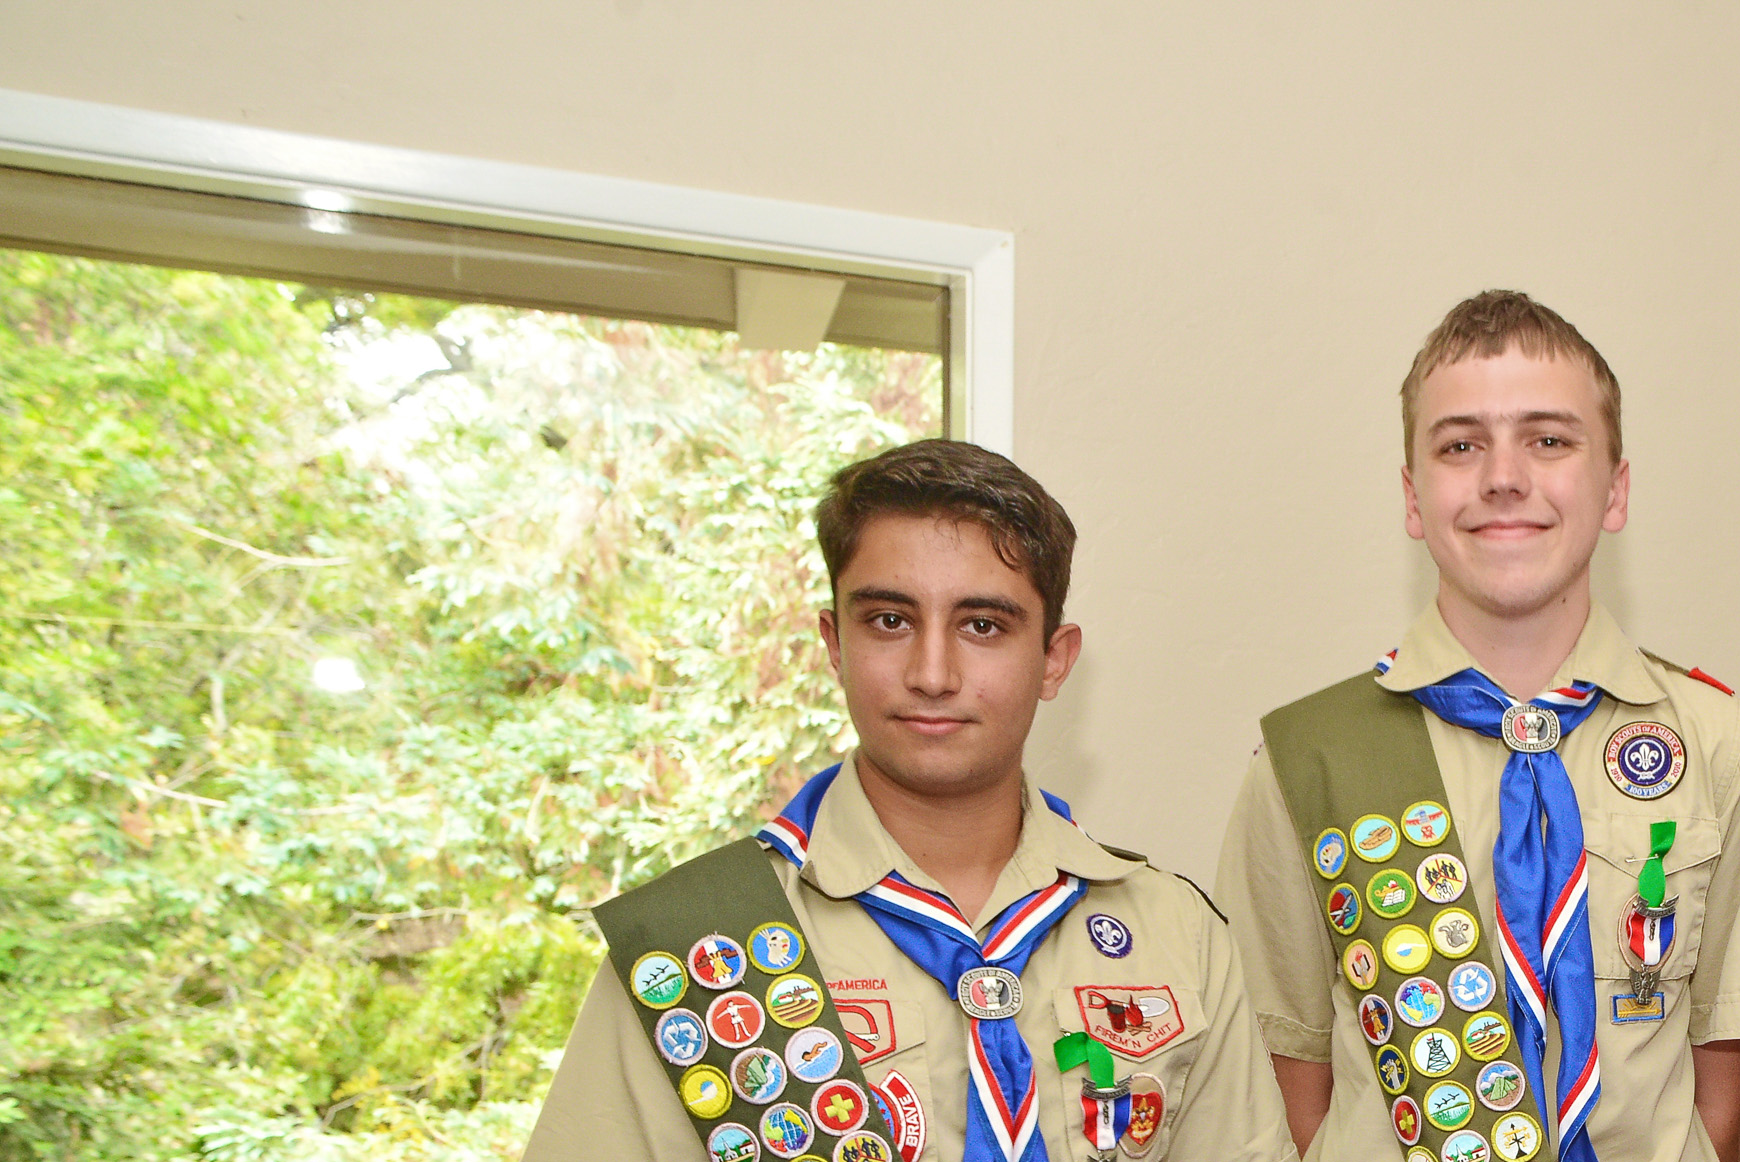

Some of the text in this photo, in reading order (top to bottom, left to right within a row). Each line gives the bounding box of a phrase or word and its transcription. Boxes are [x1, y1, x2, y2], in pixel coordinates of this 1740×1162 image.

[1609, 742, 1619, 758] BOY
[1615, 725, 1641, 744] SCOUTS
[1650, 726, 1681, 754] AMERICA
[1611, 768, 1623, 782] 1910
[1671, 762, 1682, 778] 2010
[1629, 782, 1668, 797] 100 YEARS
[837, 978, 888, 991] AMERICA
[1146, 1022, 1172, 1043] CHIT
[899, 1093, 920, 1148] BRAVE
